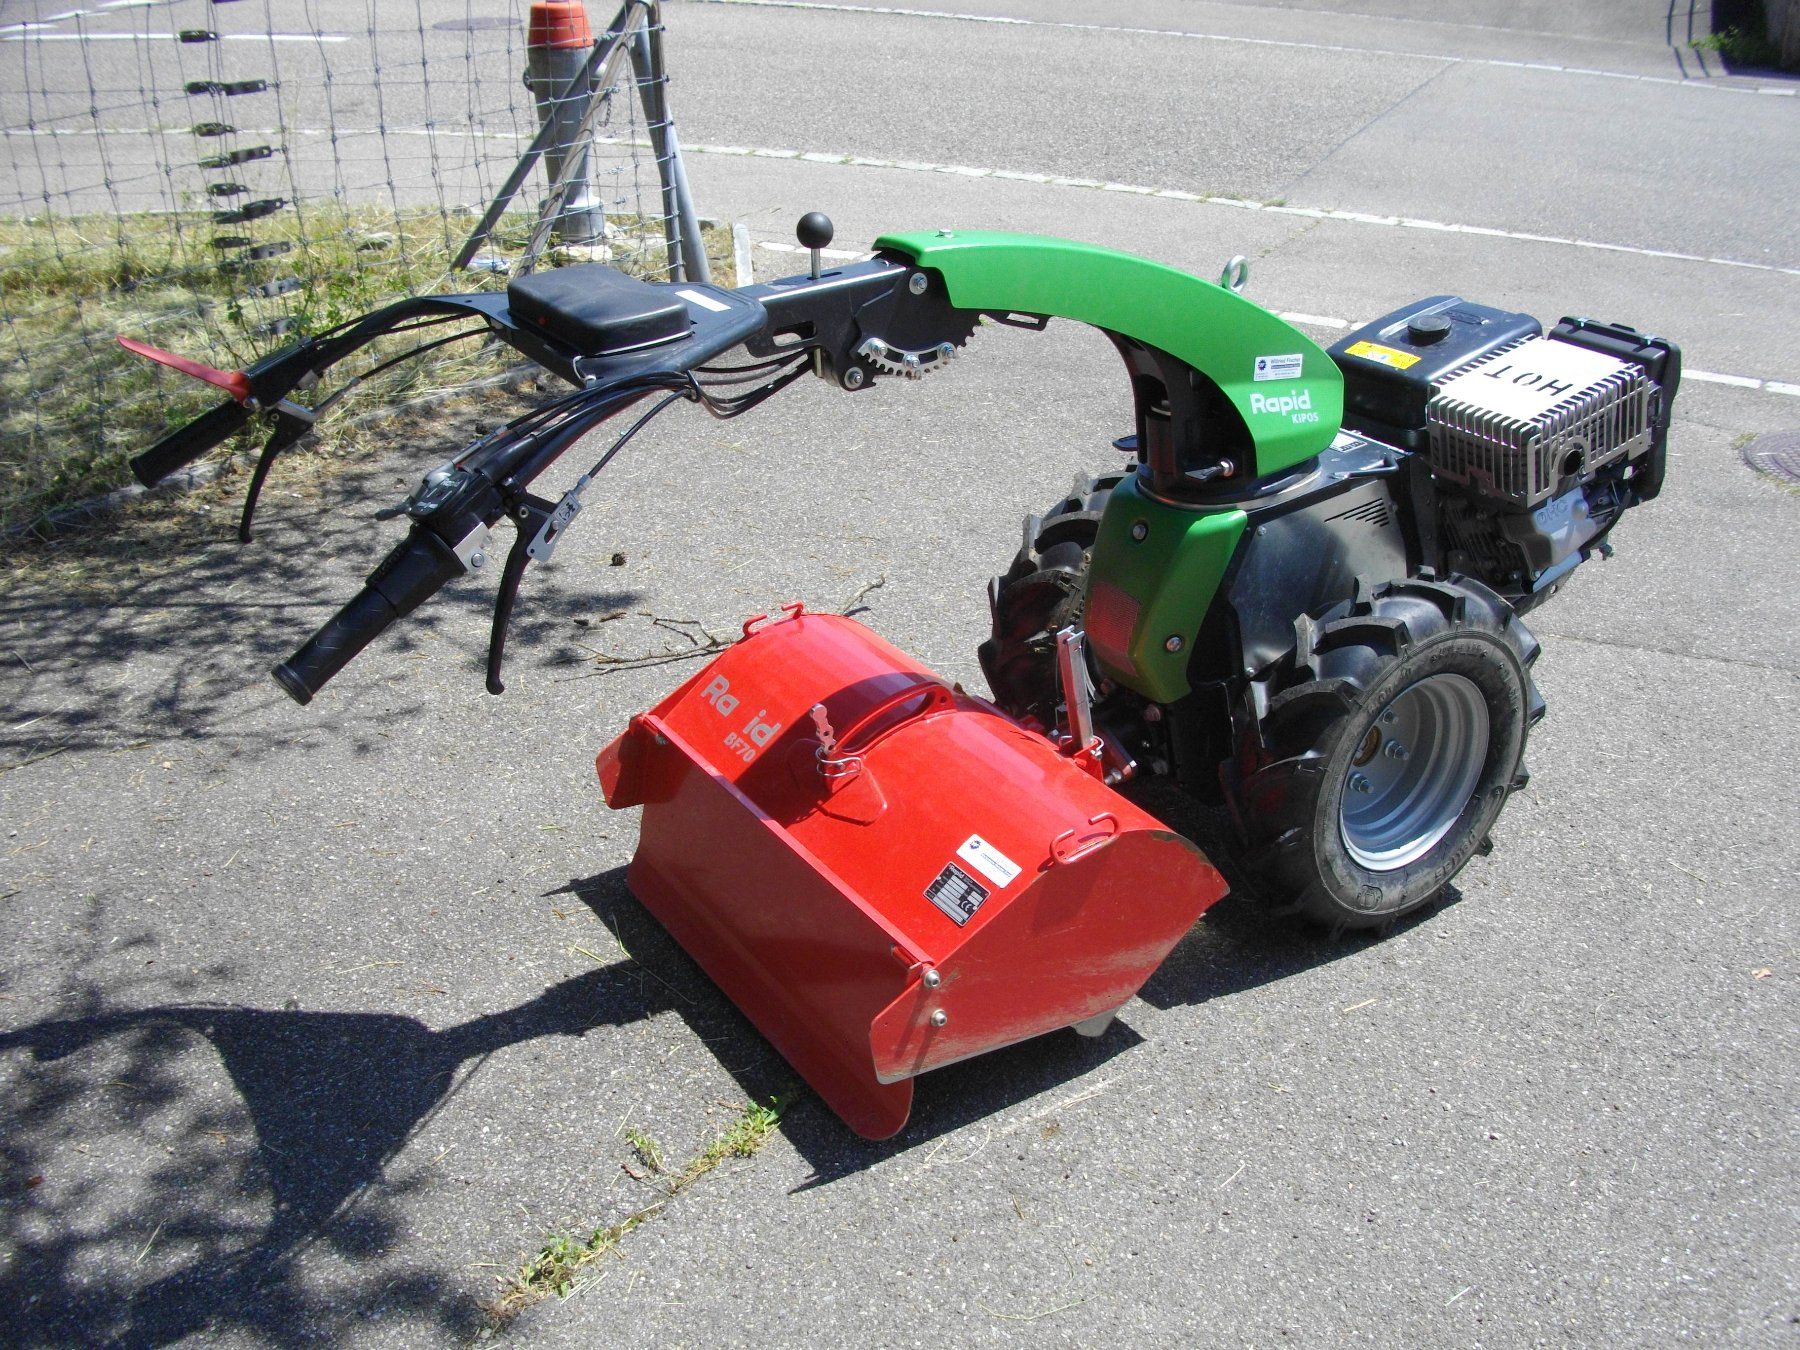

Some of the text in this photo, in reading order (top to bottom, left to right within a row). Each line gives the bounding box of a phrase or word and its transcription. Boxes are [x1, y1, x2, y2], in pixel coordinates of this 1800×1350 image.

[1483, 365, 1573, 396] HOT
[1250, 389, 1312, 416] Rapid
[1291, 412, 1320, 424] KIPOS
[700, 674, 781, 747] Raid
[723, 731, 756, 762] BF70
